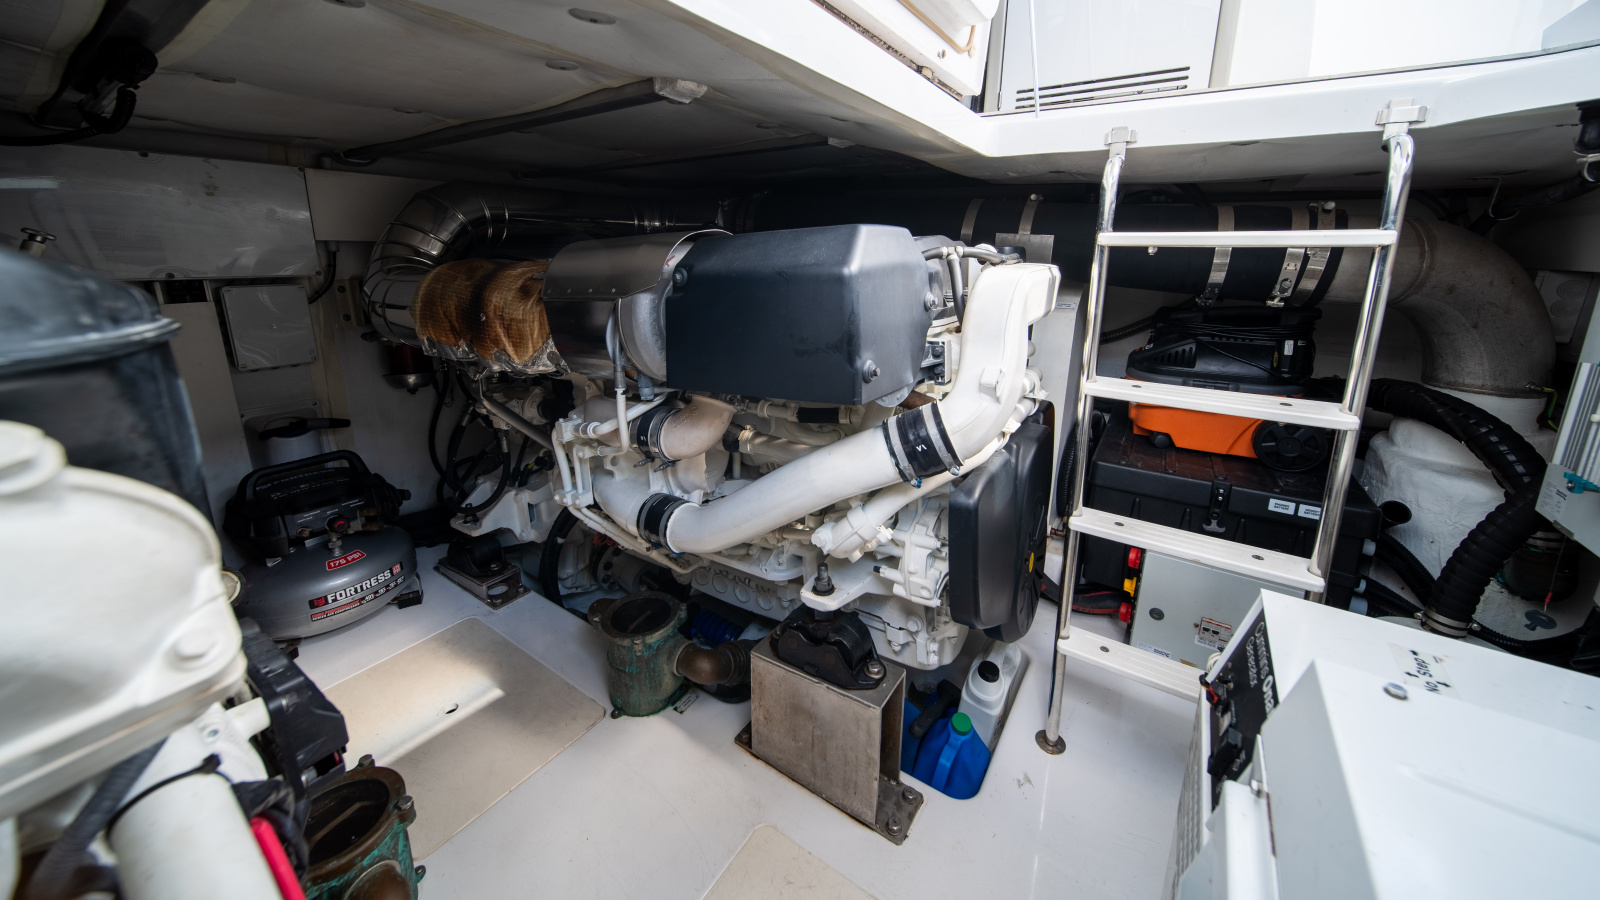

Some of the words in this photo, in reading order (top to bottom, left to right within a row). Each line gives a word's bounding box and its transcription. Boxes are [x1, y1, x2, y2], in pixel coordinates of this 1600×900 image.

[329, 559, 346, 568] 175
[346, 552, 362, 562] PSI
[327, 569, 391, 604] FORTRESS
[1255, 621, 1270, 680] Cummins
[1413, 657, 1433, 678] Step
[1262, 674, 1275, 715] Ona
[1424, 681, 1442, 695] No
